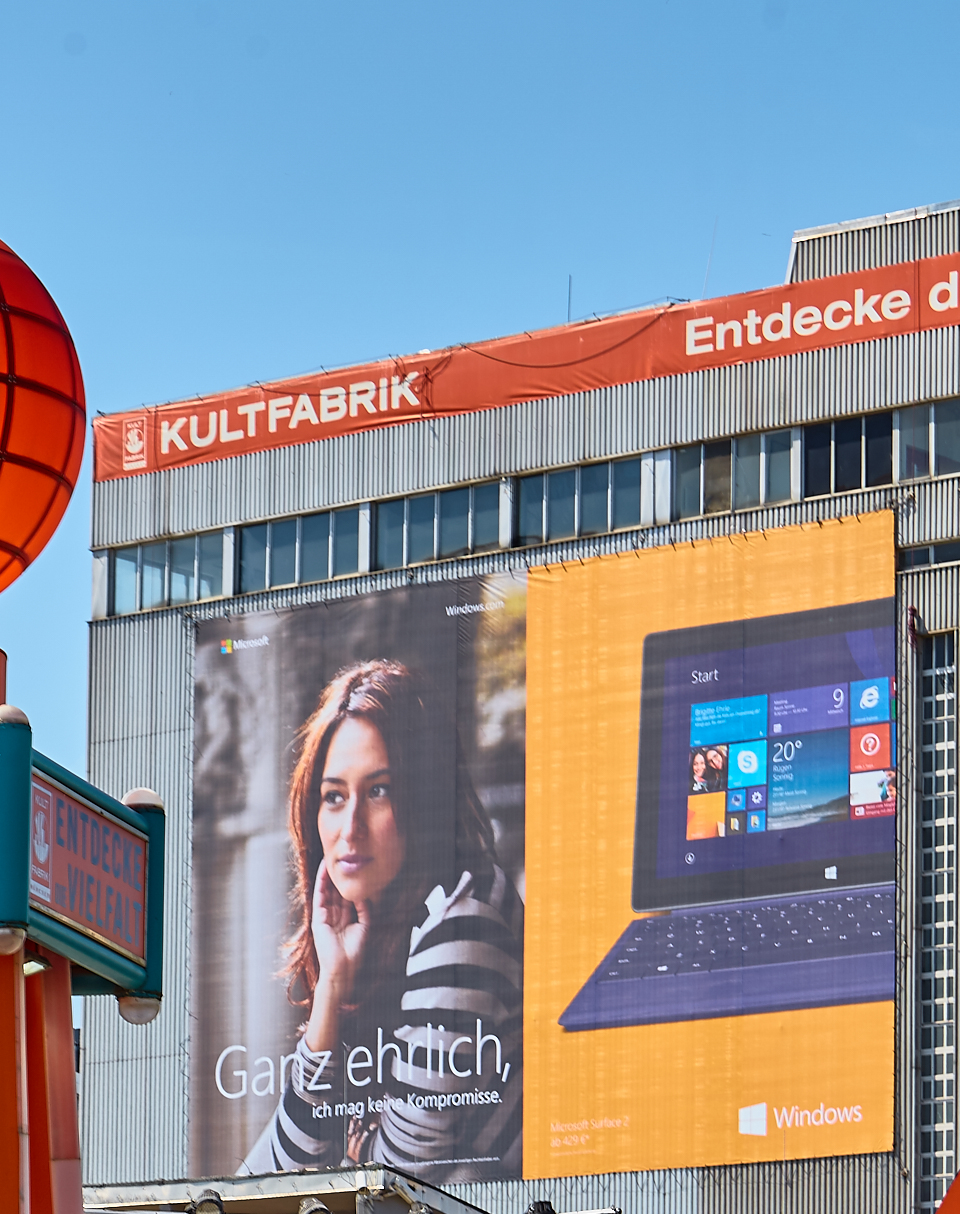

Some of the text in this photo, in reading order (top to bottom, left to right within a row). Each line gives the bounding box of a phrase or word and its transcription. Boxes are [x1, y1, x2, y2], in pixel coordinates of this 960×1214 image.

[685, 288, 911, 355] Entdecke
[160, 372, 420, 454] KULTFABRIK
[445, 599, 505, 617] Windows.com
[233, 635, 270, 650] Microsoft
[691, 669, 719, 684] Start
[833, 688, 844, 709] 9
[56, 797, 143, 892] ENTDECKE
[68, 863, 143, 947] VIELFALT
[215, 1018, 511, 1099] Ganz ehrlich,
[311, 1088, 503, 1119] ich mag keine Kompromisse.
[773, 1102, 862, 1129] Windows
[550, 1118, 589, 1132] Microsoft
[590, 1117, 622, 1130] Surface
